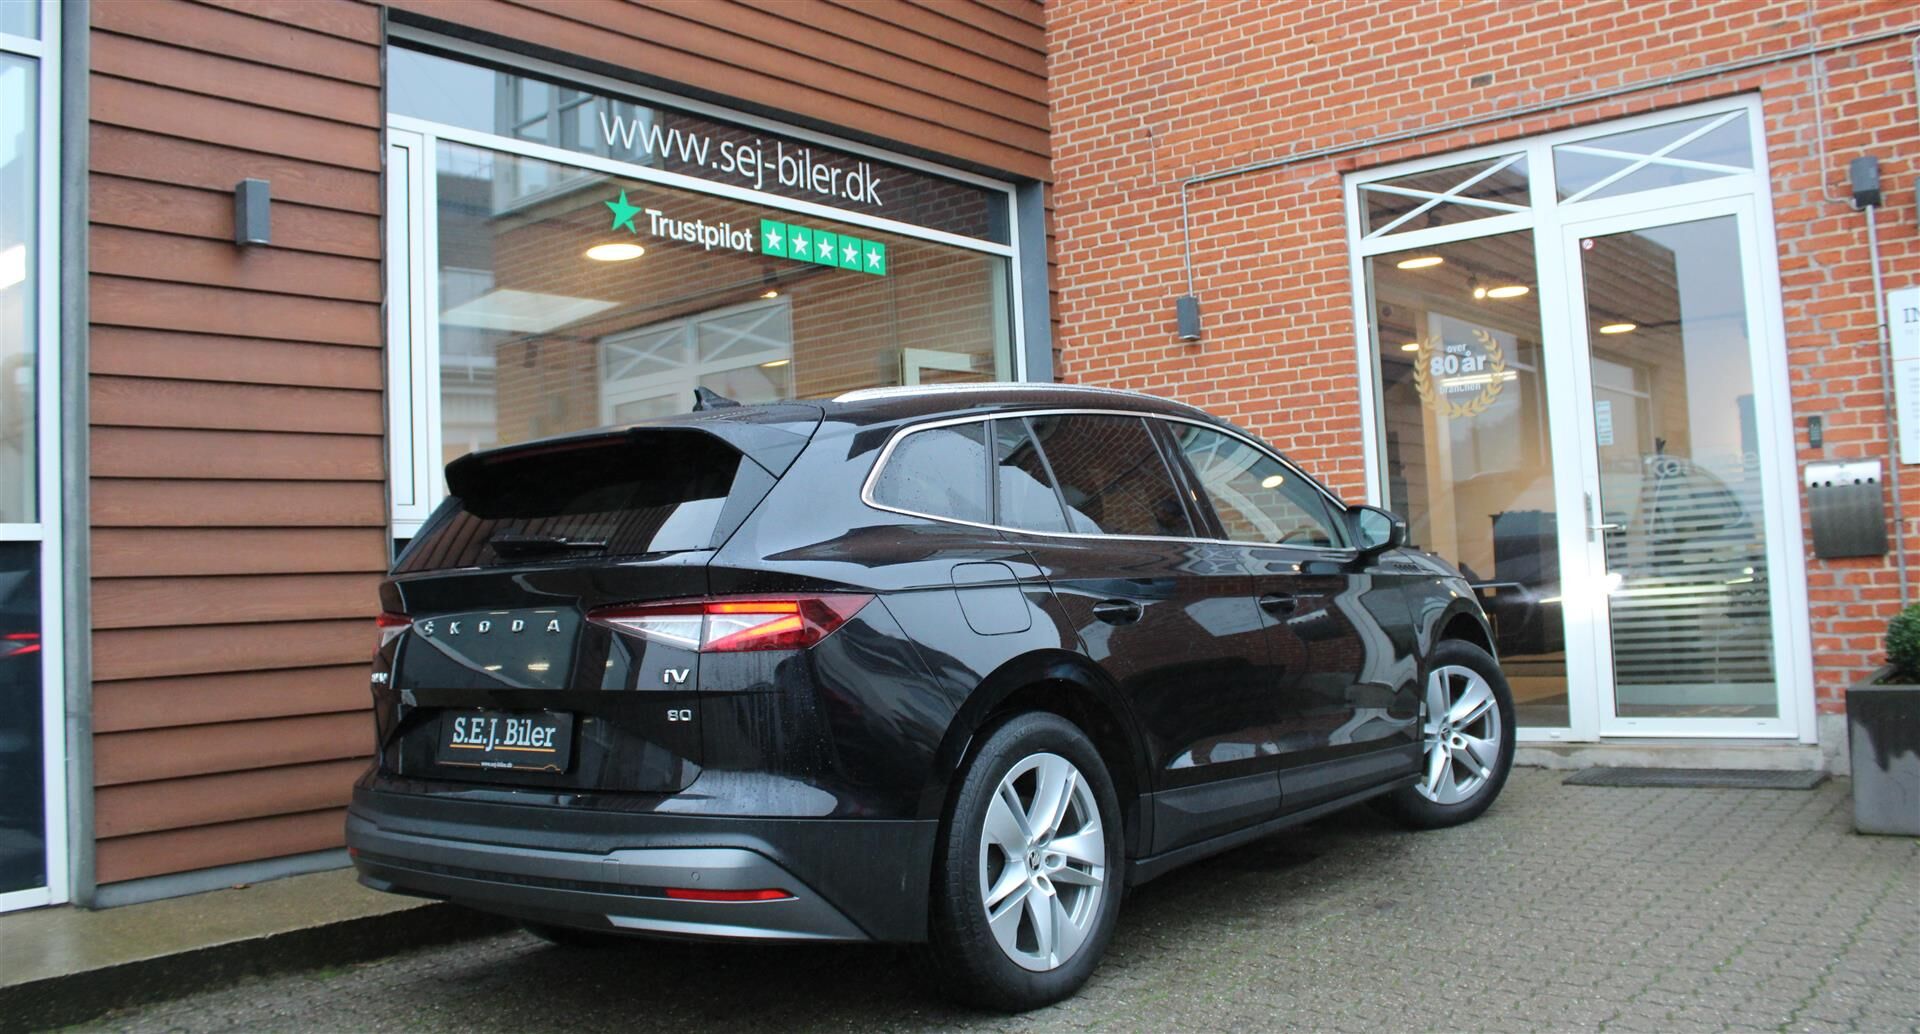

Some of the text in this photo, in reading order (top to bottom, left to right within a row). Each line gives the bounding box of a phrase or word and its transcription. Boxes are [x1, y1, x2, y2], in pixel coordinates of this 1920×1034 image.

[600, 111, 883, 206] www.sej-biler.dk
[645, 208, 753, 252] Trustpilot
[1430, 350, 1486, 376] 80 år
[1447, 343, 1467, 353] over
[667, 709, 692, 721] 80
[453, 716, 556, 751] S.E.J. Biler
